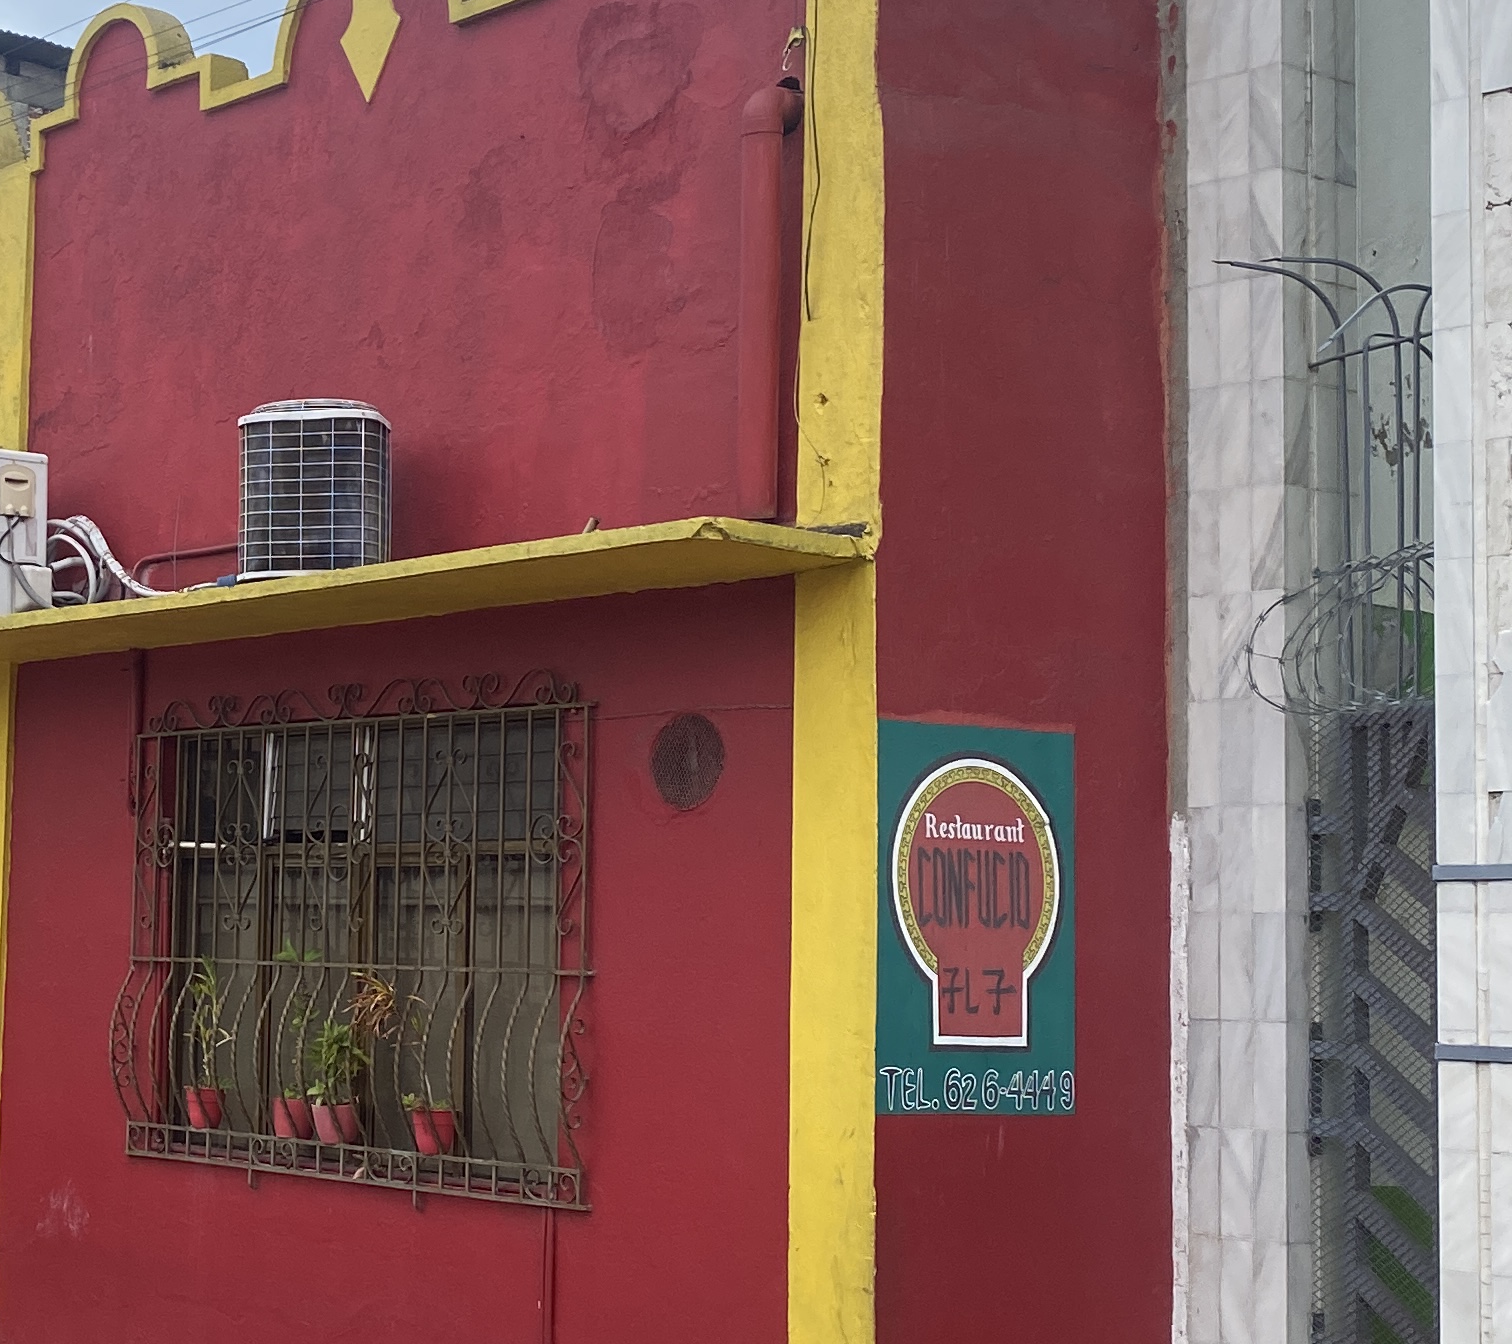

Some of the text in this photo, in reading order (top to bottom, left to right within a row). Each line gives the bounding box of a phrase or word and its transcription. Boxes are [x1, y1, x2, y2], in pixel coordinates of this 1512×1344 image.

[924, 812, 1025, 844] Restaurant
[917, 847, 1030, 930] CONFUCIO
[879, 1066, 1075, 1112] TEL. 626-4449
